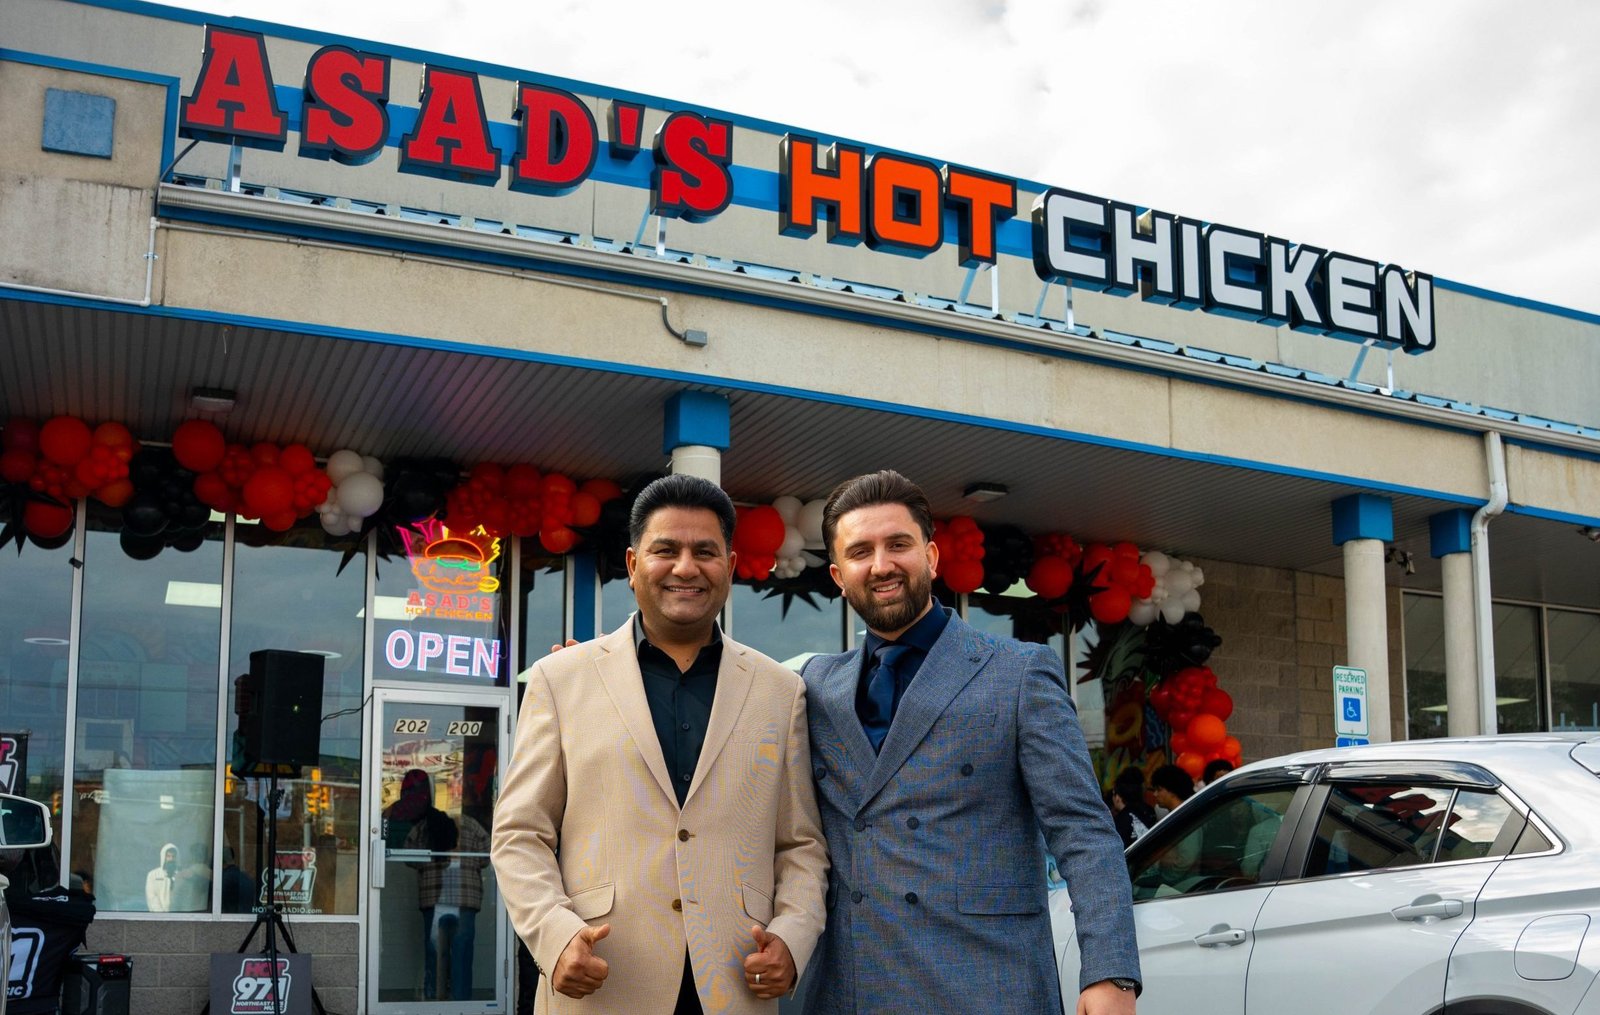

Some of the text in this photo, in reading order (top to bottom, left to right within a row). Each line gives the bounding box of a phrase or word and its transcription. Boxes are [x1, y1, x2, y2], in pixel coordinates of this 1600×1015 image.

[180, 24, 1436, 355] ASAD'S HOT CHICKEN
[407, 592, 492, 612] ASAD'S
[405, 607, 493, 621] HOT CHICKEN
[386, 629, 500, 679] OPEN
[1336, 673, 1365, 684] RESERVED
[1338, 685, 1363, 695] PARKING
[396, 720, 427, 733] 202
[449, 722, 479, 735] 200
[244, 962, 286, 977] HOT
